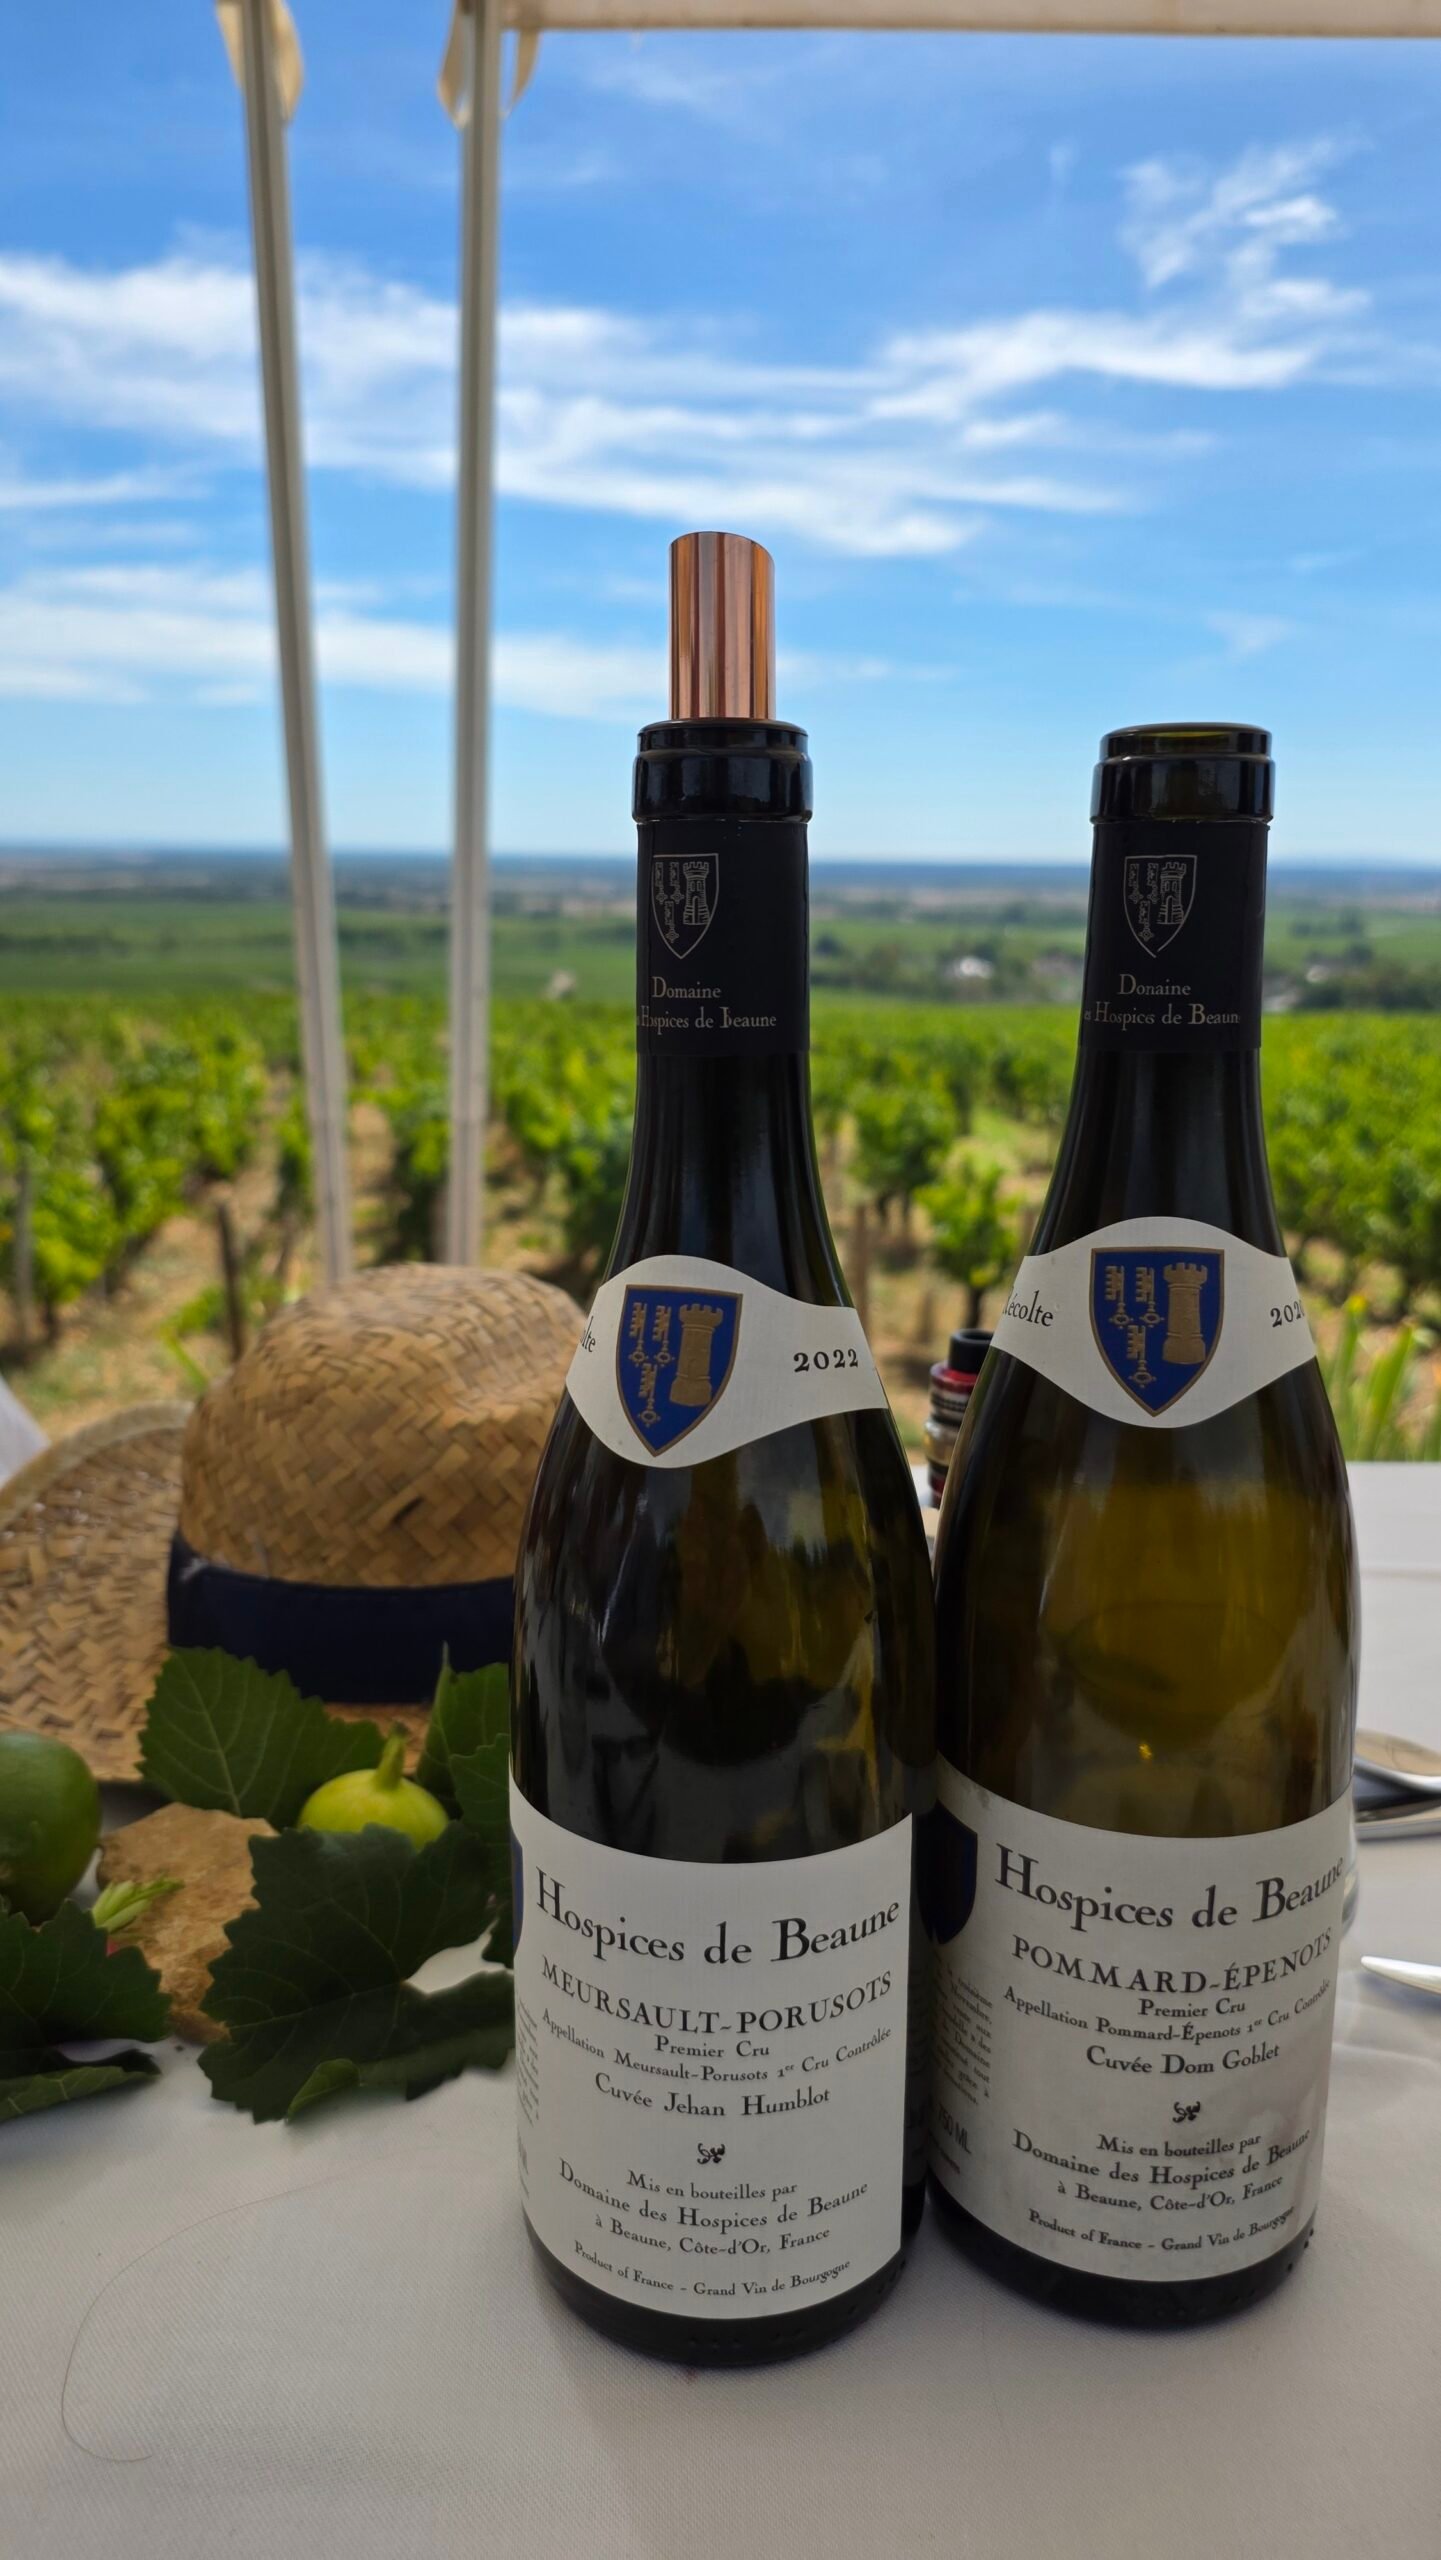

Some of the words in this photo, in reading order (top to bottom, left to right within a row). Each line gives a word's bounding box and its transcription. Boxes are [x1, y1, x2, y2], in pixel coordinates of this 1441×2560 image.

[652, 976, 721, 998] Domaine
[695, 1006, 714, 1029] de
[1162, 1003, 1183, 1025] de
[1188, 1003, 1241, 1025] Beaun
[793, 1348, 859, 1373] 2022
[994, 1842, 1174, 1933] Hospices
[1192, 1884, 1238, 1929] de
[1252, 1857, 1343, 1923] Beaune
[536, 1866, 685, 1962] Hospices
[704, 1921, 752, 1964] de
[770, 1901, 899, 1962] Beaune
[1011, 1926, 1332, 1994] POMMARD-ÉPENOTS
[542, 1954, 893, 2034] MEURSAULT-PORUSOTS
[1138, 1997, 1208, 2019] Premier
[1215, 1997, 1246, 2016] Cru
[1004, 1985, 1089, 2030] Appellation
[1095, 2016, 1241, 2046] Pommard-Épenots
[1247, 2018, 1263, 2033] 1er
[1267, 2010, 1290, 2027] Cru
[543, 2008, 606, 2058] Appellation
[614, 2048, 768, 2082] Meursault-Porusots
[777, 2064, 795, 2078] 1er
[801, 2056, 829, 2073] Cru
[836, 2027, 892, 2063] Contrôlée
[655, 2034, 725, 2058] Premier
[736, 2040, 770, 2057] Cru
[1086, 2045, 1153, 2074] Cuvée
[1160, 2053, 1215, 2075] Dom
[1222, 2041, 1280, 2070] Goblet
[595, 2072, 653, 2108] Cuvée
[664, 2091, 726, 2117] Jehan
[741, 2086, 831, 2117] Humblot
[1012, 2128, 1100, 2177] Domaine
[1109, 2161, 1140, 2183] des
[1149, 2165, 1236, 2191] Hospices
[1242, 2155, 1260, 2175] de
[1267, 2129, 1310, 2167] Beaune
[1096, 2133, 1134, 2155] Mis
[1139, 2147, 1158, 2158] en
[1164, 2138, 1235, 2158] bouteilles
[1239, 2135, 1262, 2154] par
[559, 2157, 630, 2212] Domaine
[639, 2199, 668, 2222] des
[677, 2206, 768, 2236] Hospices
[777, 2204, 799, 2224] de
[807, 2183, 868, 2218] Beaune
[626, 2169, 661, 2193] Mis
[666, 2185, 685, 2198] en
[691, 2181, 766, 2200] bouteilles
[771, 2183, 798, 2202] par
[1058, 2180, 1067, 2194] à
[1075, 2182, 1142, 2211] Beaune,
[1150, 2190, 1236, 2211] Côte-d'Or,
[1242, 2176, 1284, 2201] France
[595, 2214, 603, 2228] à
[610, 2217, 672, 2252] Beaune,
[679, 2236, 771, 2255] Côte-d'Or,
[779, 2228, 830, 2251] France
[1028, 2208, 1077, 2238] Product
[1081, 2229, 1096, 2242] of
[1100, 2231, 1143, 2250] France
[1161, 2237, 1203, 2252] Grand
[1207, 2232, 1230, 2247] Vin
[1233, 2228, 1246, 2242] de
[575, 2239, 613, 2273] Product
[618, 2266, 630, 2279] of
[633, 2268, 674, 2291] France
[693, 2282, 736, 2297] Grand
[742, 2281, 767, 2296] Vin
[771, 2278, 786, 2292] de
[790, 2260, 851, 2289] Bourgogne
